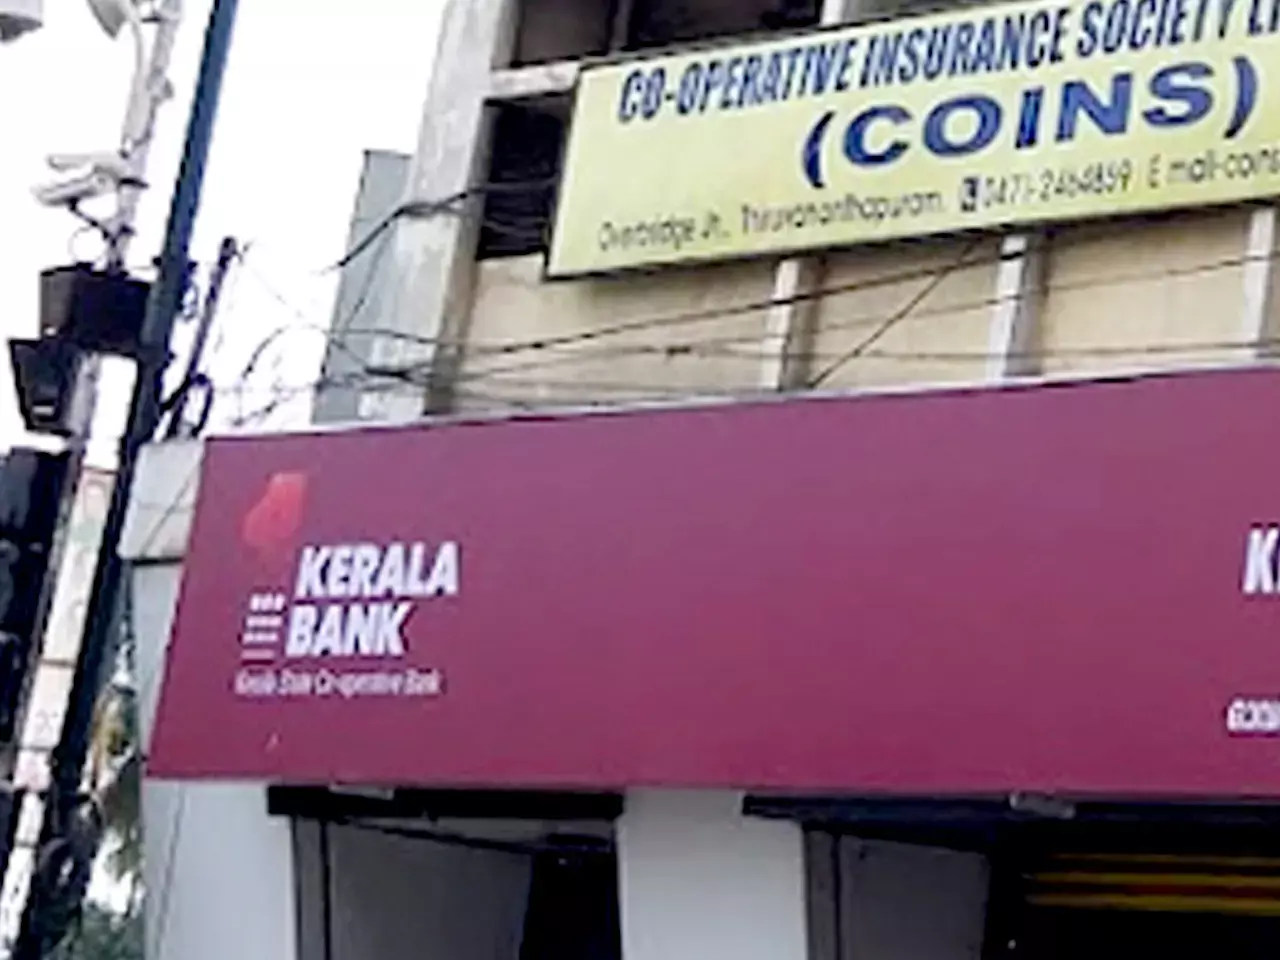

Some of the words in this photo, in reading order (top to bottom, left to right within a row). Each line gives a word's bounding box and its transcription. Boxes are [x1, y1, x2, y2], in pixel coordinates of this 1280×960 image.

[618, 38, 858, 122] CO-OPERATIVE
[860, 8, 1068, 88] INSURANCE
[1077, 0, 1229, 58] SOCIETY
[802, 55, 1258, 188] (COINS)
[294, 541, 458, 599] KERALA
[285, 602, 412, 657] BANK
